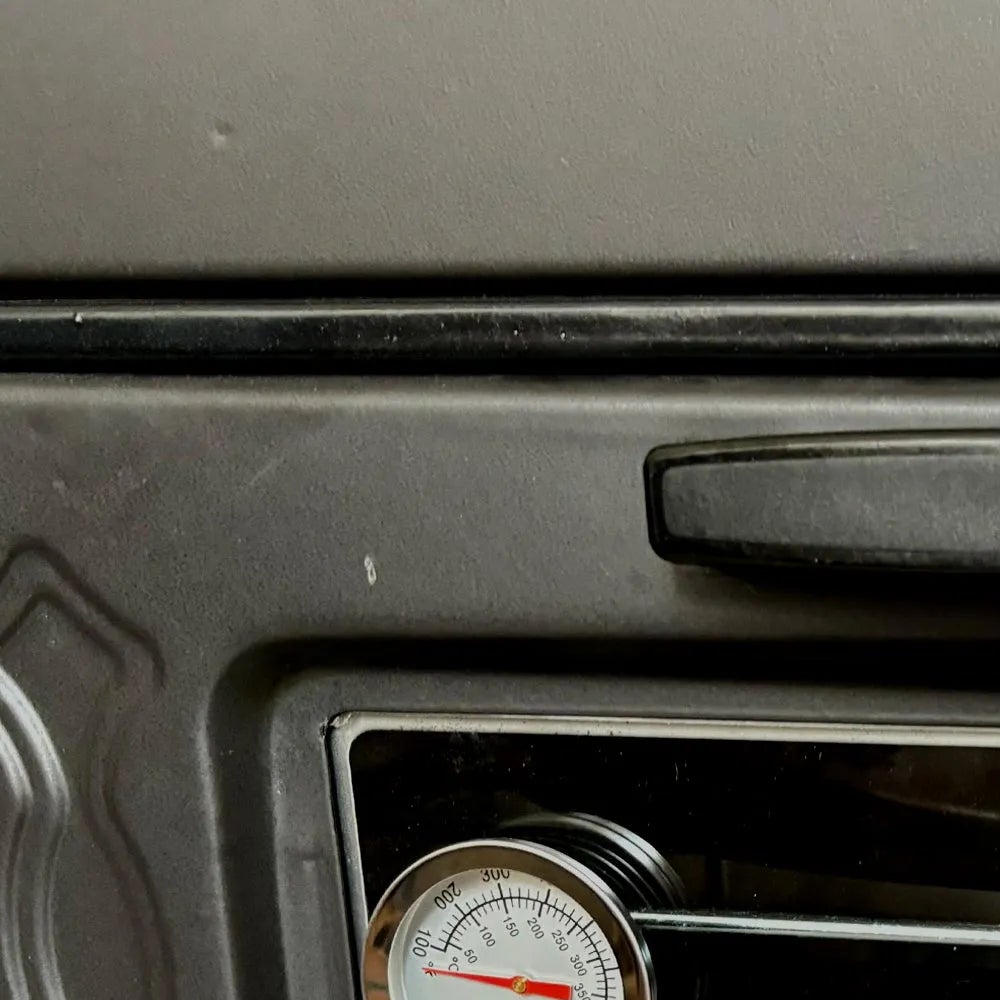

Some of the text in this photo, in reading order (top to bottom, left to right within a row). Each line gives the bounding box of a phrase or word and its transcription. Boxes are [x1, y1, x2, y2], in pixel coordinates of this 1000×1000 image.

[434, 881, 462, 910] 200
[479, 926, 496, 947] 100
[503, 916, 520, 937] 150
[527, 917, 545, 939] 200
[412, 929, 432, 957] 100
[551, 929, 569, 952] 250
[464, 949, 478, 964] 50
[570, 954, 587, 977] 300
